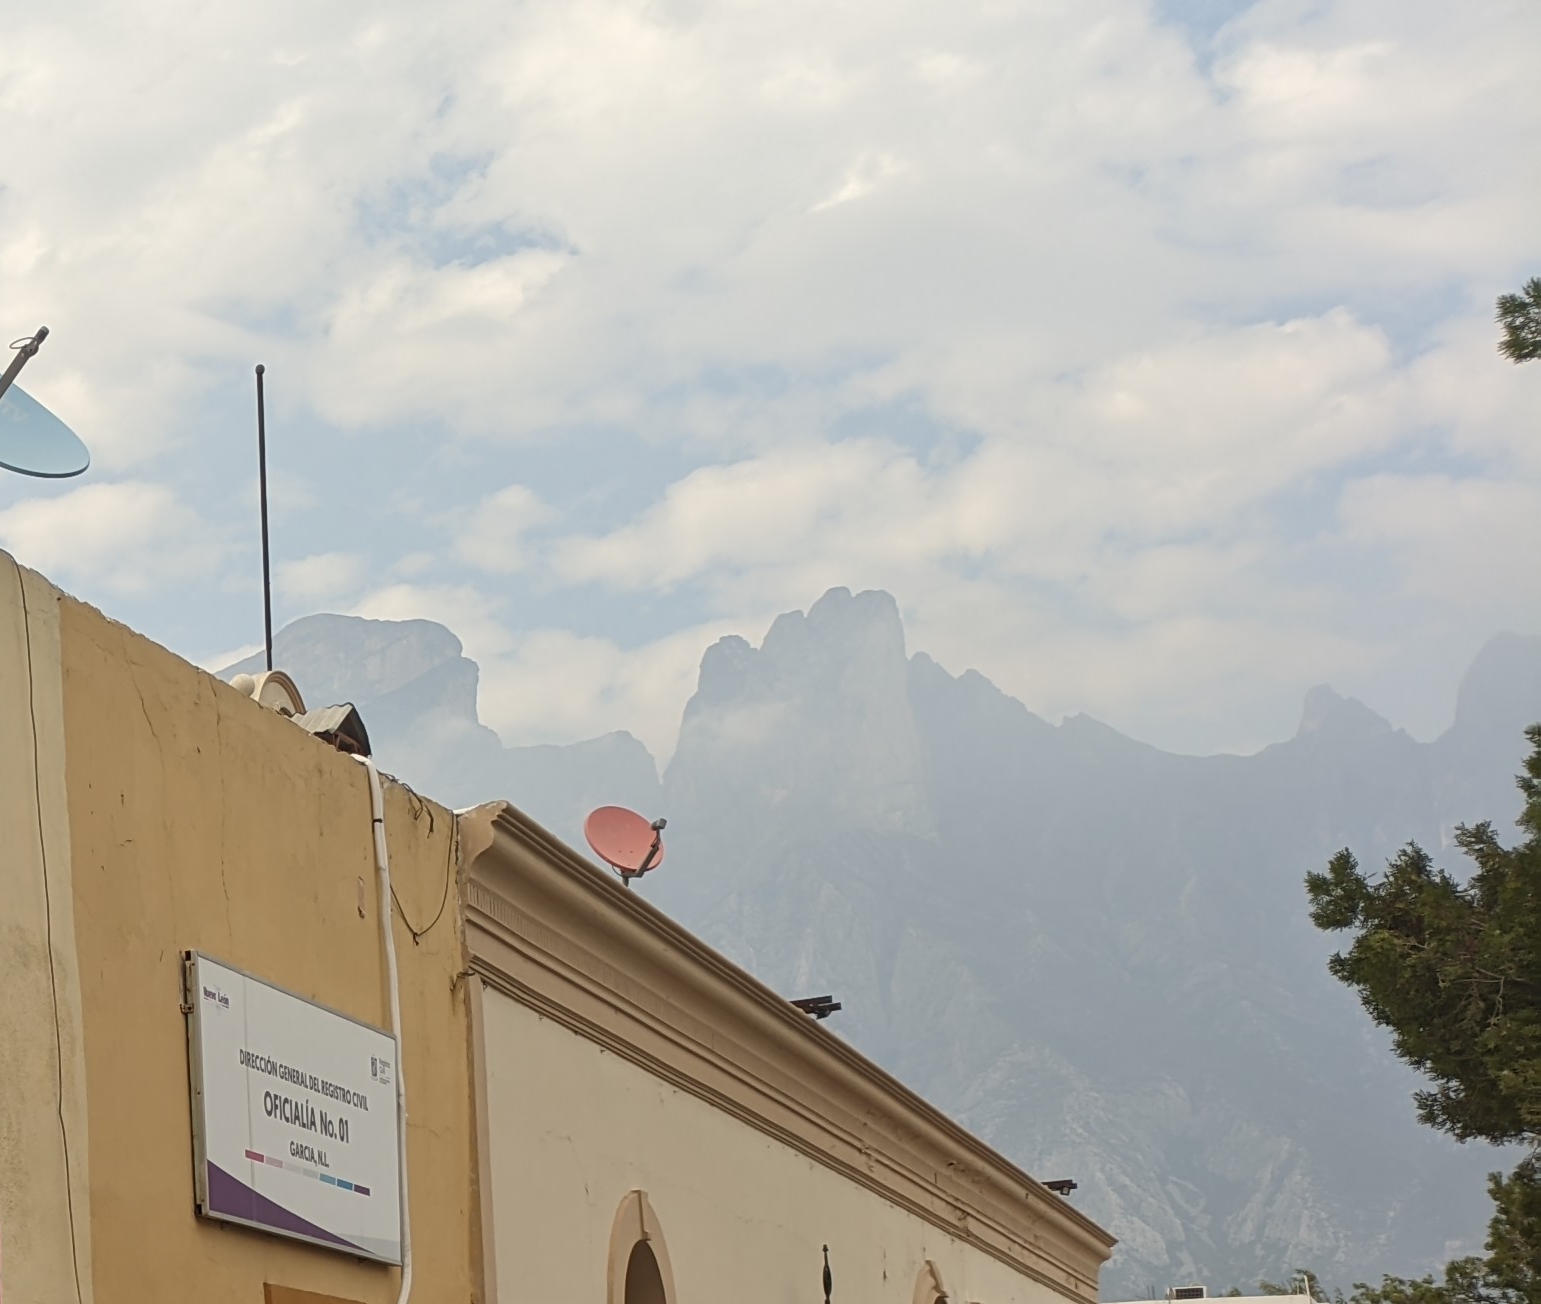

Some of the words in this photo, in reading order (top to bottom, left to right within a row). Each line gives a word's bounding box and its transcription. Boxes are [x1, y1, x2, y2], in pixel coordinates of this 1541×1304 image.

[239, 1048, 278, 1077] DIRECCIÓN
[278, 1063, 309, 1090] GENERAL
[309, 1074, 321, 1094] DEL
[321, 1079, 352, 1106] REGISTRO
[352, 1091, 369, 1112] CIVIL
[263, 1090, 318, 1133] OFICIALÍA
[319, 1109, 337, 1140] No.
[338, 1117, 349, 1144] 01
[317, 1149, 330, 1168] N.L.
